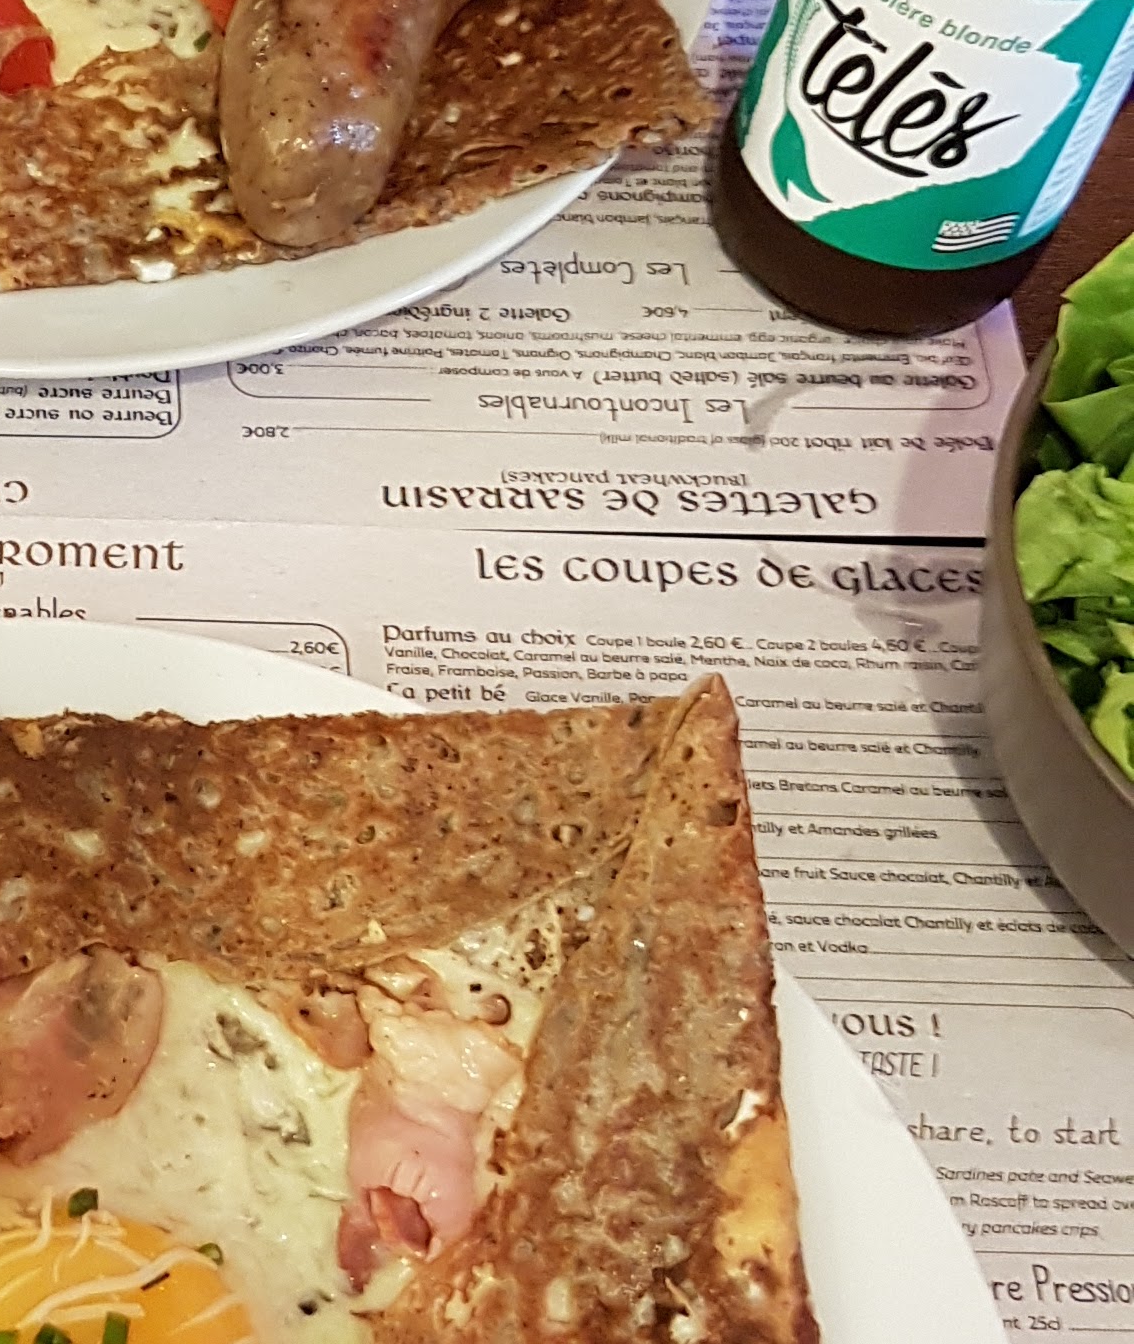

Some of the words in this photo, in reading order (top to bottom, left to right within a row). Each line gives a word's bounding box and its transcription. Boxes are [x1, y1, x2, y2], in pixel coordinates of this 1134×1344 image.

[938, 19, 1032, 53] blonde
[500, 252, 633, 285] Complètes
[646, 262, 690, 286] Les
[5, 408, 59, 420] sucre
[69, 410, 94, 421] ou
[102, 410, 172, 426] Beurre
[478, 395, 693, 424] Incontournables
[705, 398, 749, 425] Les
[290, 640, 340, 656] 2,60€
[382, 624, 476, 644] Parfums
[486, 631, 511, 643] au
[521, 628, 577, 647] choix
[690, 637, 725, 649] 2,60
[425, 684, 471, 703] petit
[481, 684, 507, 702] bé
[1007, 1115, 1041, 1145] to
[1054, 1117, 1120, 1146] start
